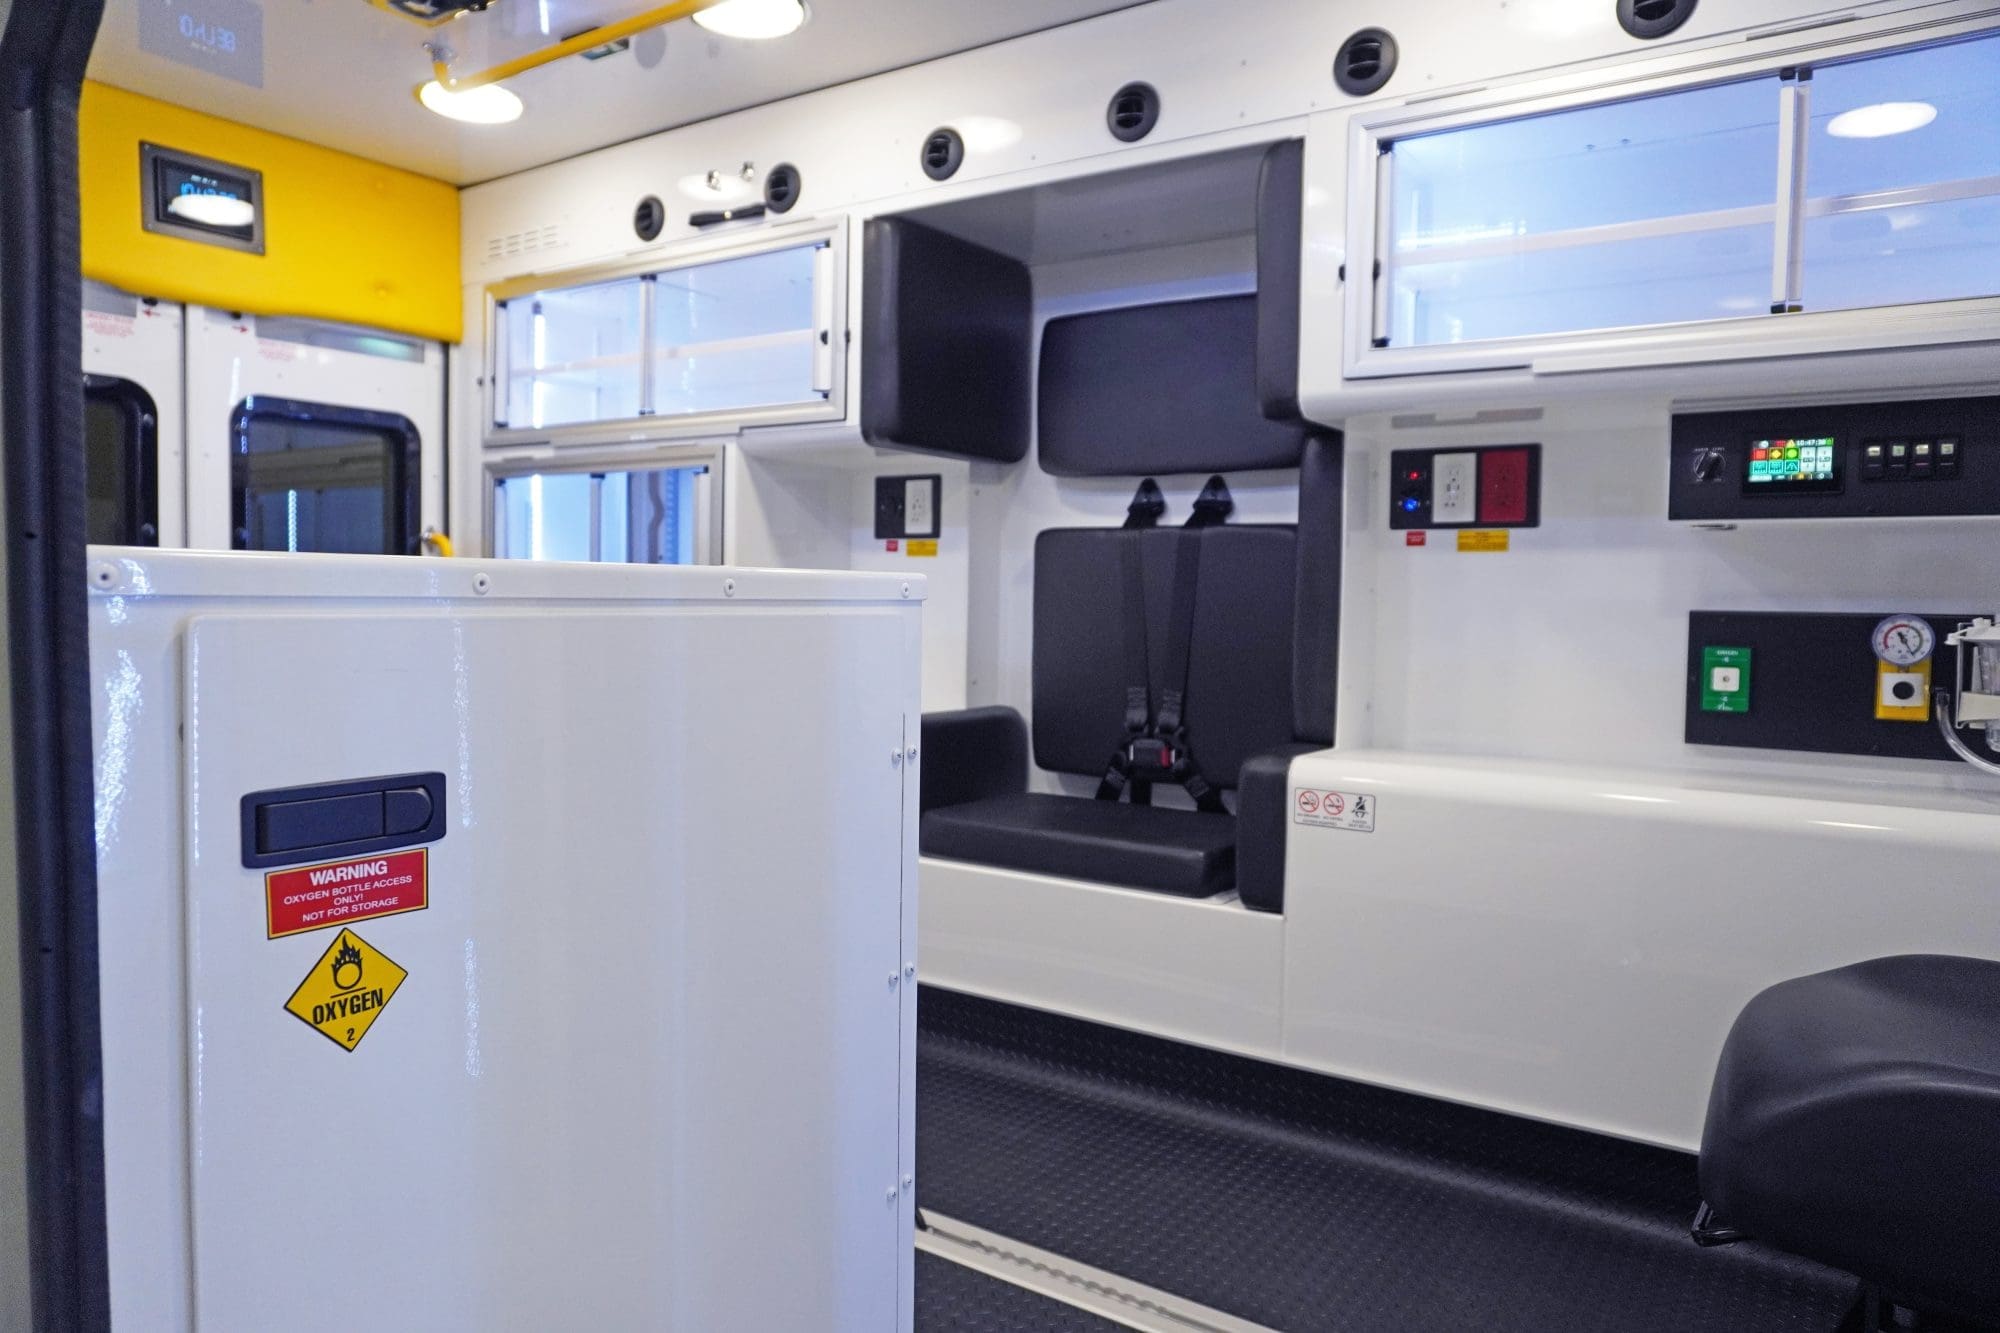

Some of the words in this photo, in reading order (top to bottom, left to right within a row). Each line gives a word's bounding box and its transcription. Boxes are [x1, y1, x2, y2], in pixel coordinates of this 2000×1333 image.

[310, 861, 388, 886] WARNING
[283, 890, 330, 905] OXYGEN
[332, 883, 371, 896] BOTTLE
[373, 875, 413, 889] ACCESS
[333, 893, 364, 906] ONLY!
[302, 908, 325, 922] NOT
[327, 904, 349, 917] FOR
[351, 896, 400, 912] STORAGE
[312, 988, 383, 1025] OXYGEN
[346, 1027, 355, 1042] 2
